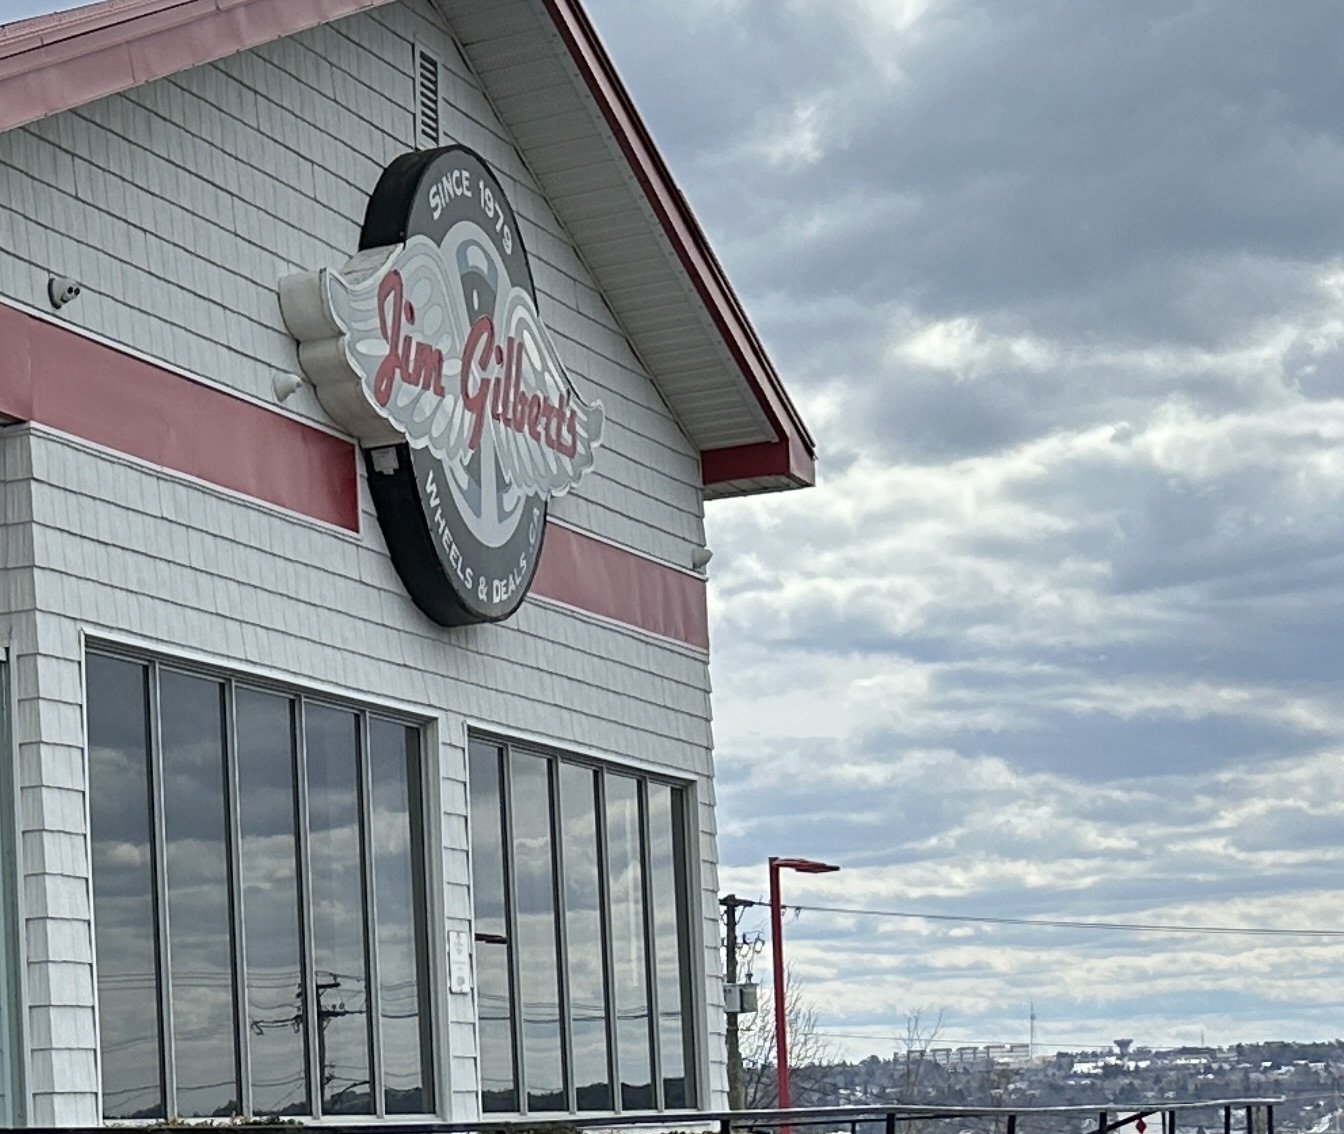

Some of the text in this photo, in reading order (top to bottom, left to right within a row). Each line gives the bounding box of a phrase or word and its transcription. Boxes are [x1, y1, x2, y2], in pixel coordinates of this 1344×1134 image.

[429, 170, 512, 254] SINCE 1979
[374, 270, 577, 458] Jim Gilbert's
[425, 469, 473, 589] WHEELS
[478, 576, 487, 602] &
[493, 552, 527, 603] DEALS
